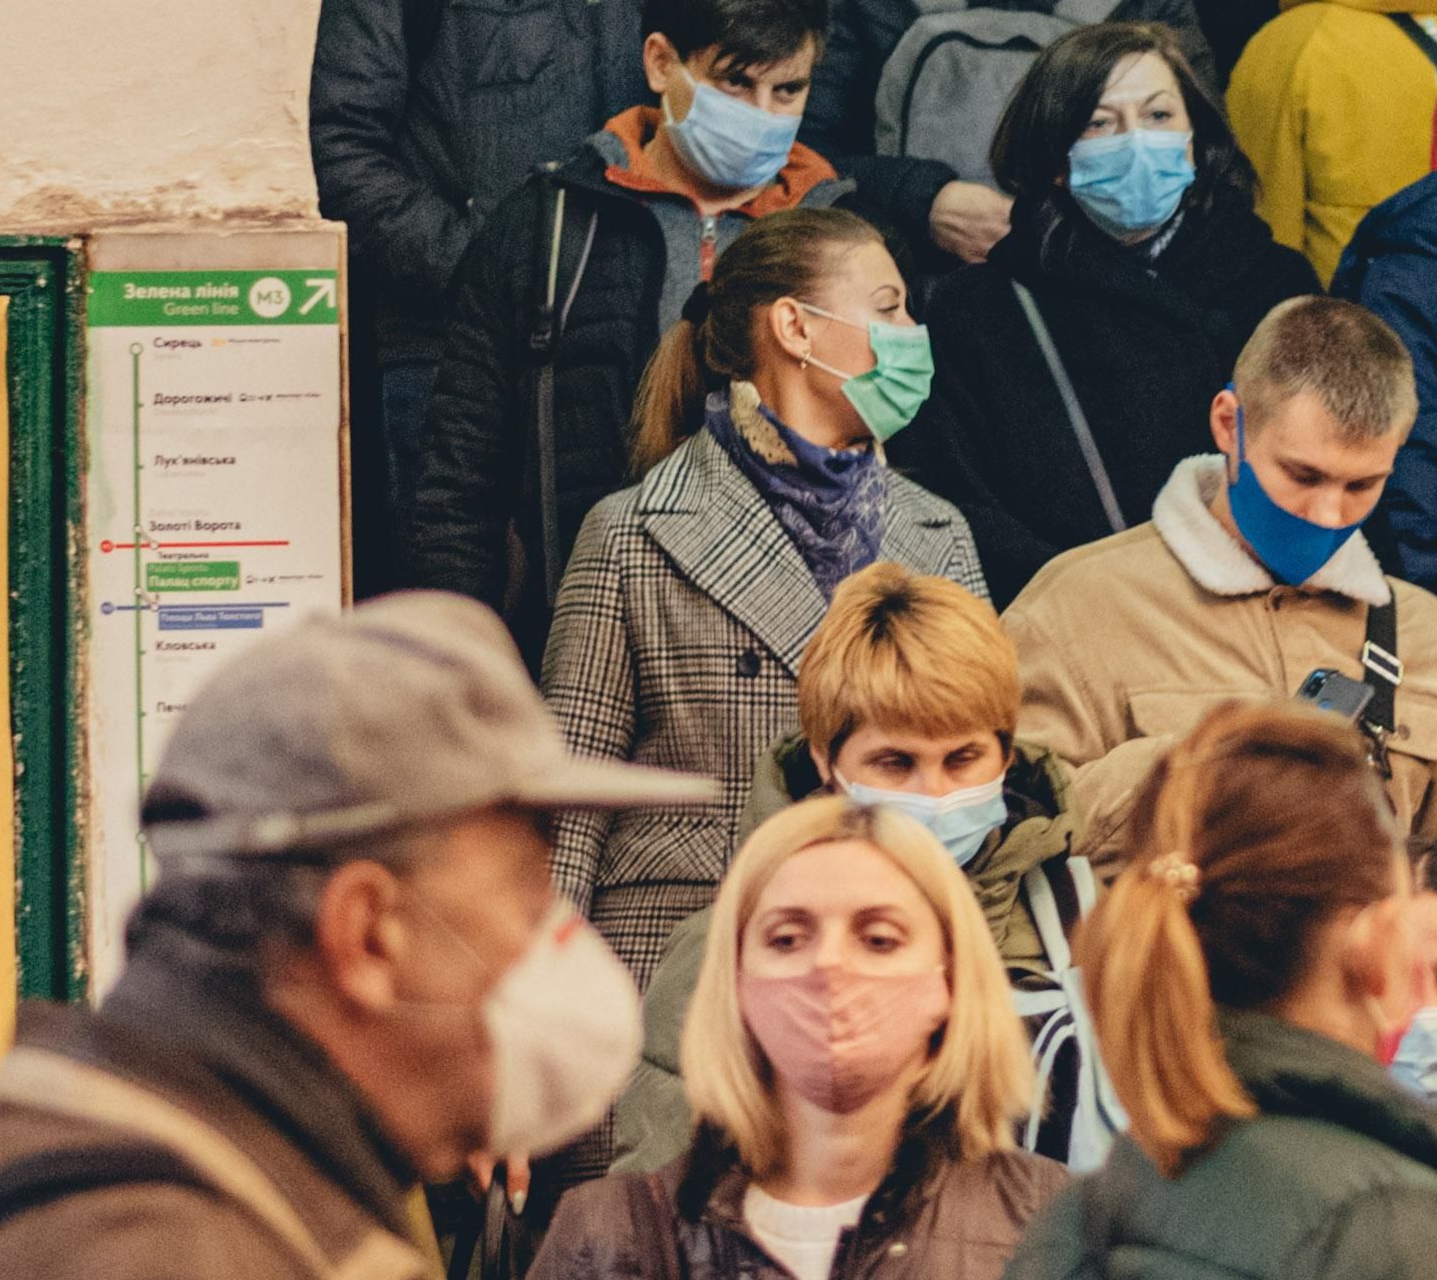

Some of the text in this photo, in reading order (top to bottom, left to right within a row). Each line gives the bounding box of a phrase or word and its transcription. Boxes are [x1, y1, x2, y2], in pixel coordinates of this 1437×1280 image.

[124, 281, 192, 300] Зелена
[195, 282, 239, 299] лінія
[163, 302, 239, 316] Green line
[152, 337, 202, 350] Сирець
[149, 520, 241, 533] Золоті Ворота
